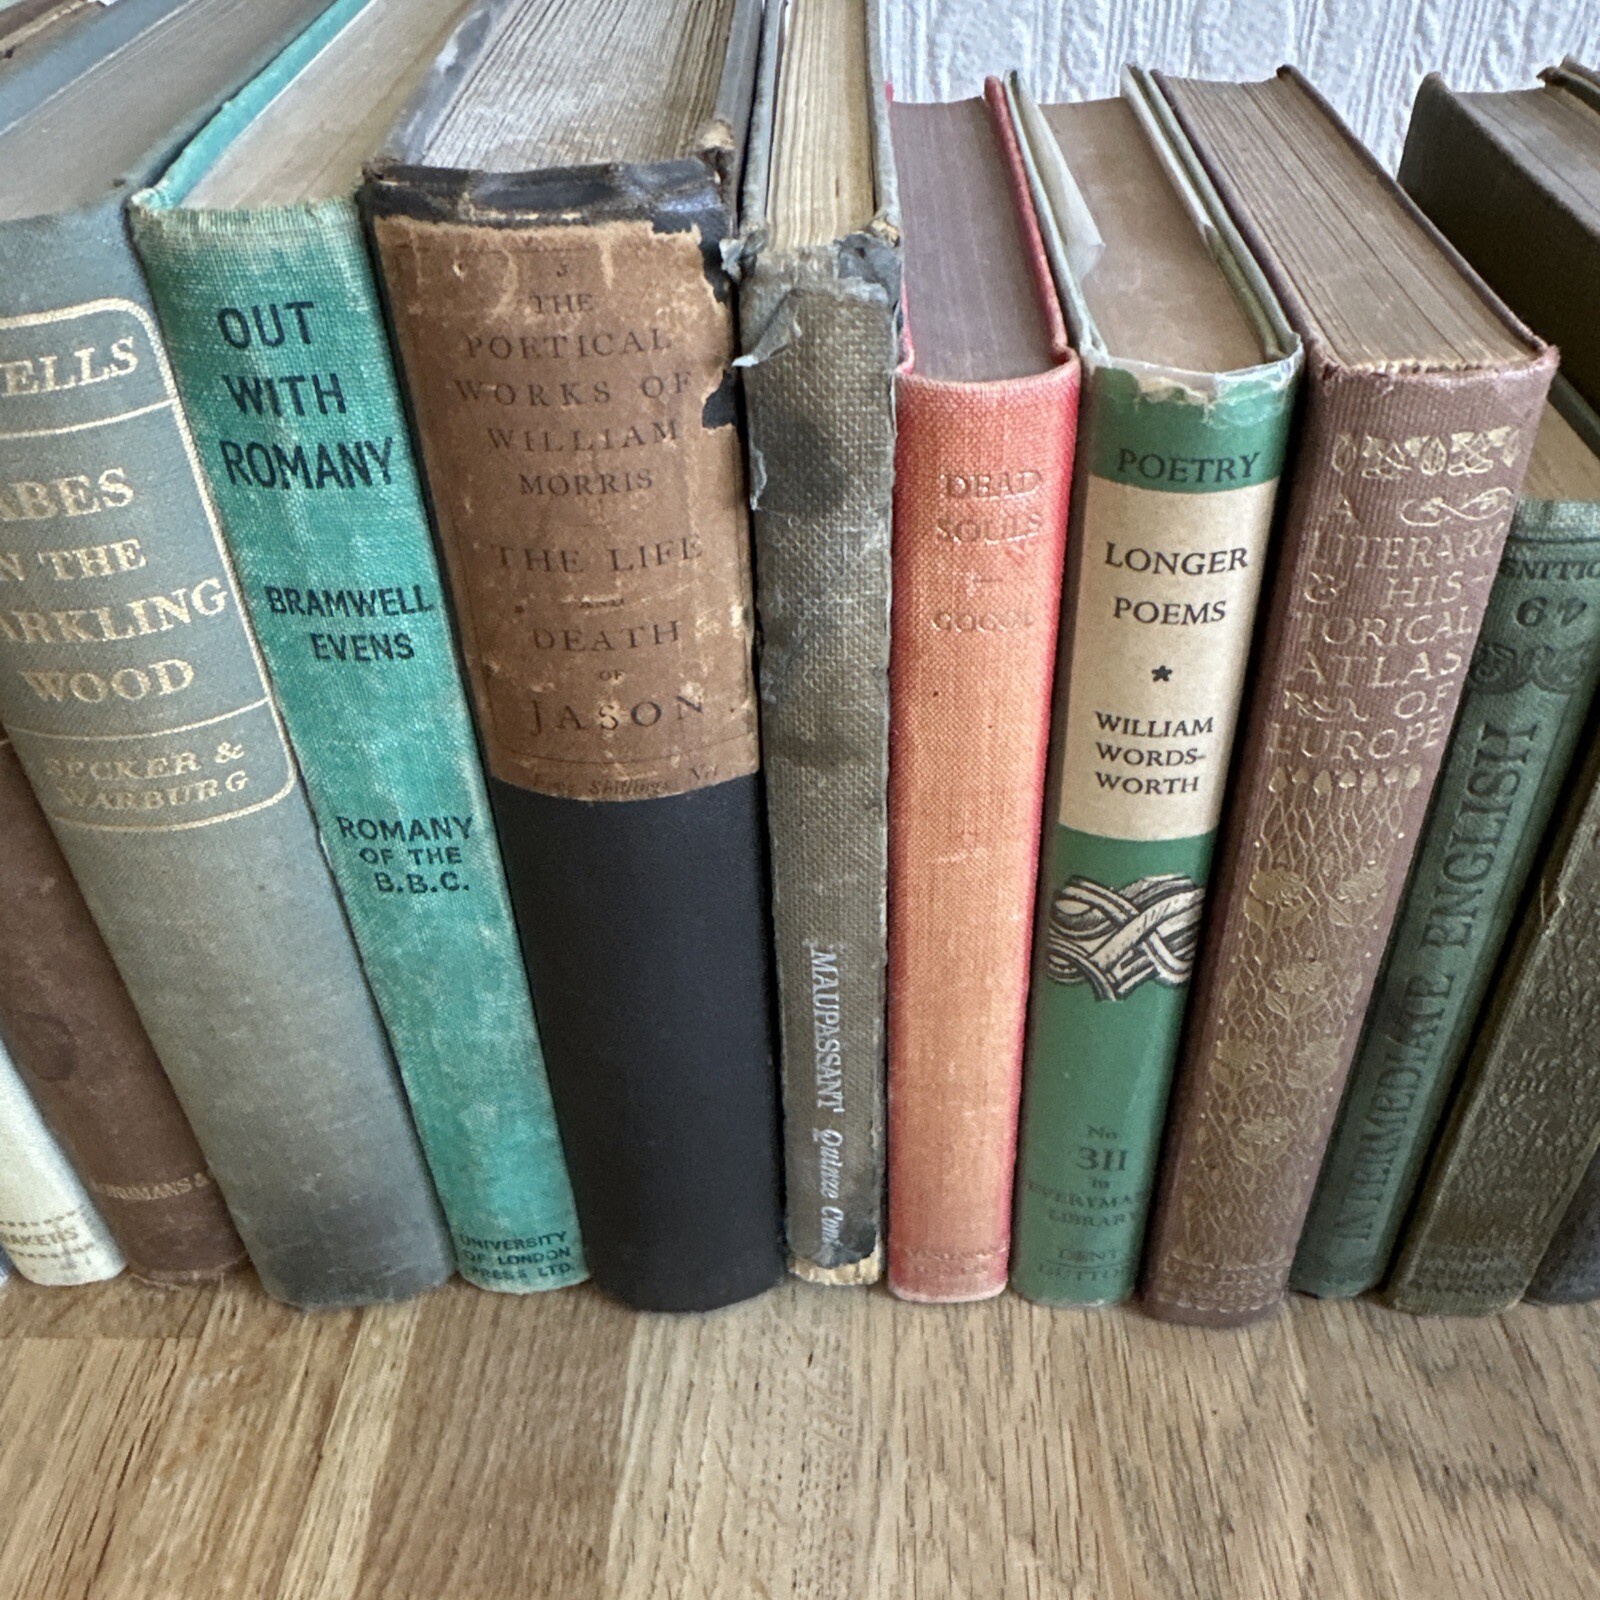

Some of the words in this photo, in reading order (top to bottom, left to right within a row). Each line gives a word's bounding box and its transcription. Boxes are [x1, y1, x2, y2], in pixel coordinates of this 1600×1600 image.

[528, 293, 594, 314] THE
[217, 301, 314, 350] OUT
[467, 328, 671, 359] POETICAL
[221, 373, 347, 418] WITH
[454, 378, 611, 407] WORKS
[640, 371, 692, 400] OF
[487, 419, 678, 451] WILLIAM
[219, 437, 394, 490] ROMANY
[1117, 448, 1260, 483] POETRY
[518, 468, 653, 496] MORRIS
[940, 470, 1043, 500] DEAD
[37, 538, 147, 582] THE
[493, 546, 584, 573] THE
[606, 535, 703, 572] LIFE
[1105, 542, 1249, 576] LONGER
[1310, 521, 1506, 569] LITERARY
[264, 584, 434, 618] BRAMWELL
[1113, 597, 1227, 626] POEMS
[310, 632, 414, 661] EVENS
[531, 620, 680, 651] DEATH
[20, 657, 195, 703] WOOD
[1296, 649, 1463, 688] ATLAS
[530, 695, 704, 737] JASON
[1395, 682, 1454, 719] OF
[1094, 711, 1214, 738] WILLIAM
[1269, 715, 1447, 761] EUROPE
[215, 741, 245, 764] &
[1095, 742, 1206, 767] WORDS-
[57, 770, 249, 811] WARBURG
[1095, 772, 1199, 795] WORTH
[336, 816, 474, 842] ROMANY
[359, 849, 395, 866] OF
[407, 846, 463, 866] THE
[373, 871, 470, 894] B.B.C.
[1335, 972, 1456, 1243] INTERMEDIATE
[1420, 721, 1542, 951] ENGLISH
[810, 947, 845, 1113] MAUPASSANT
[812, 1128, 843, 1201] Quinze
[460, 1231, 567, 1250] UNIVERSITY
[497, 1247, 571, 1265] LONDON
